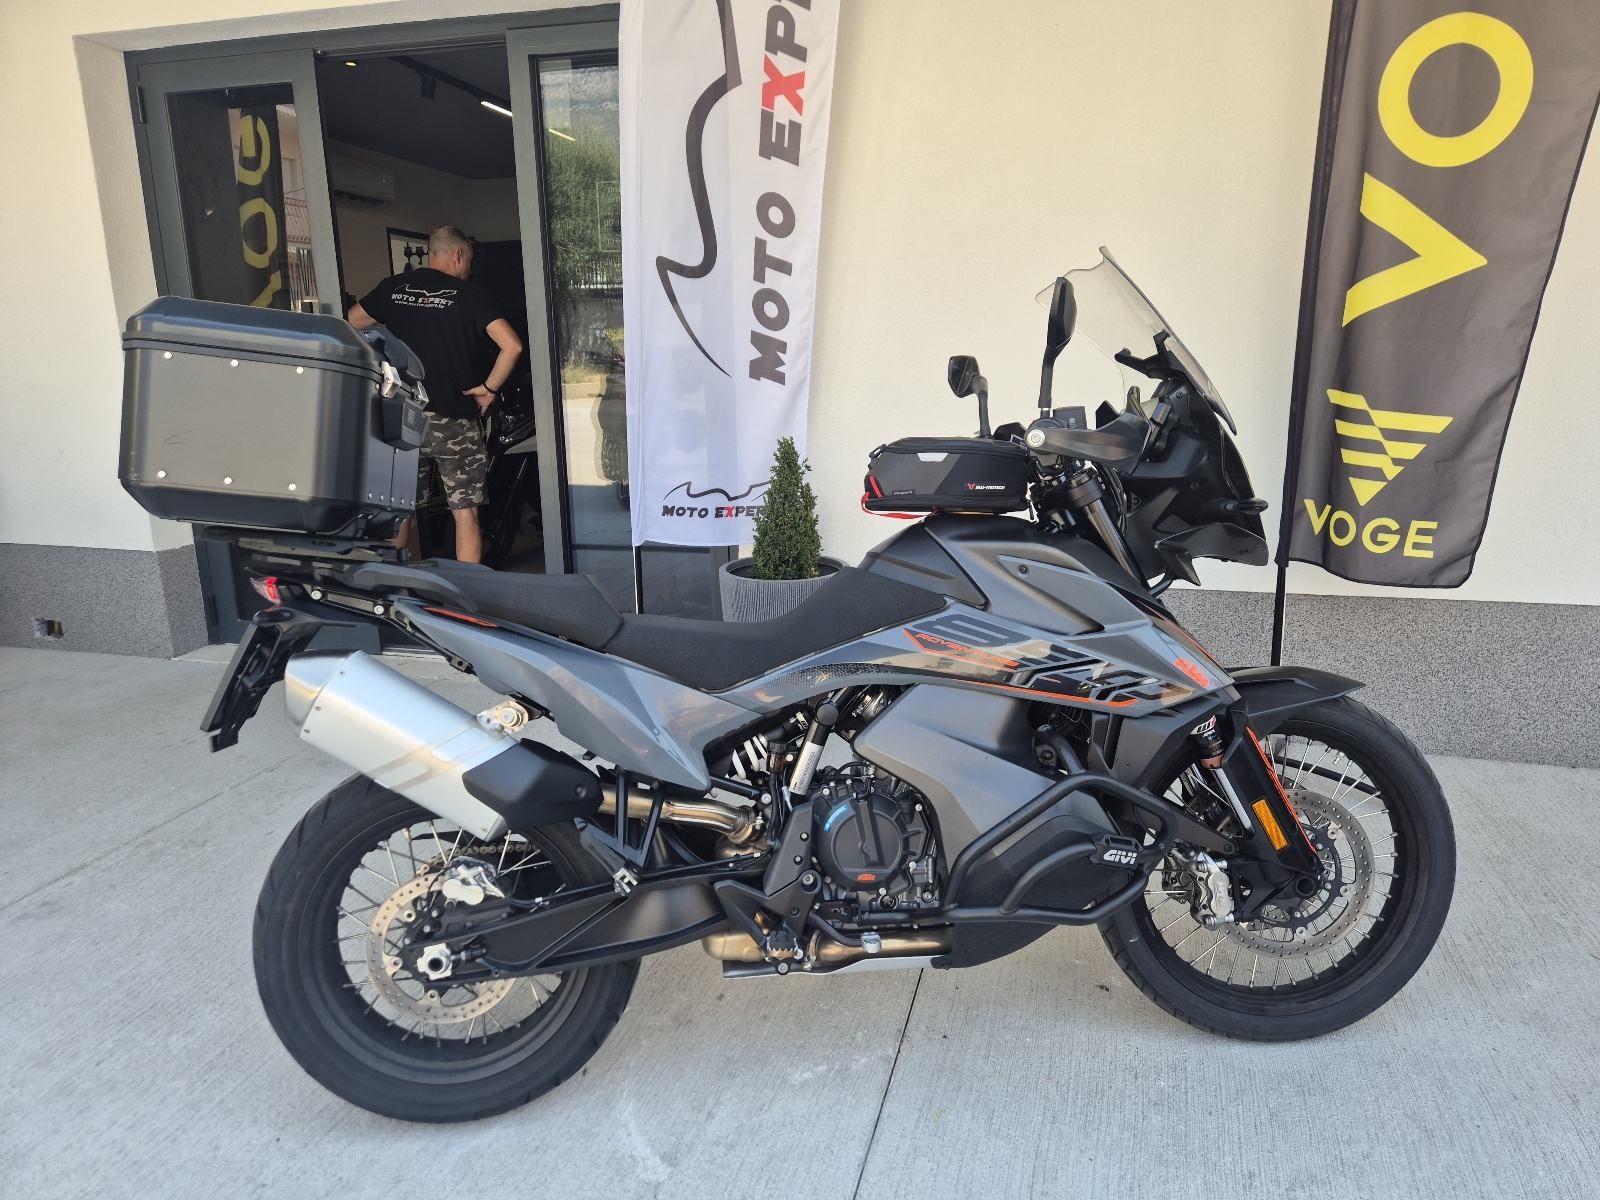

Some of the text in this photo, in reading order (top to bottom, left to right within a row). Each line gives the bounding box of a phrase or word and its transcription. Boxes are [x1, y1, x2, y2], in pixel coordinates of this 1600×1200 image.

[749, 0, 811, 386] MOTO EXP
[418, 297, 455, 306] EXPERT
[662, 505, 709, 519] MOTO
[1303, 498, 1438, 559] VOGE
[1103, 849, 1138, 865] GIVI
